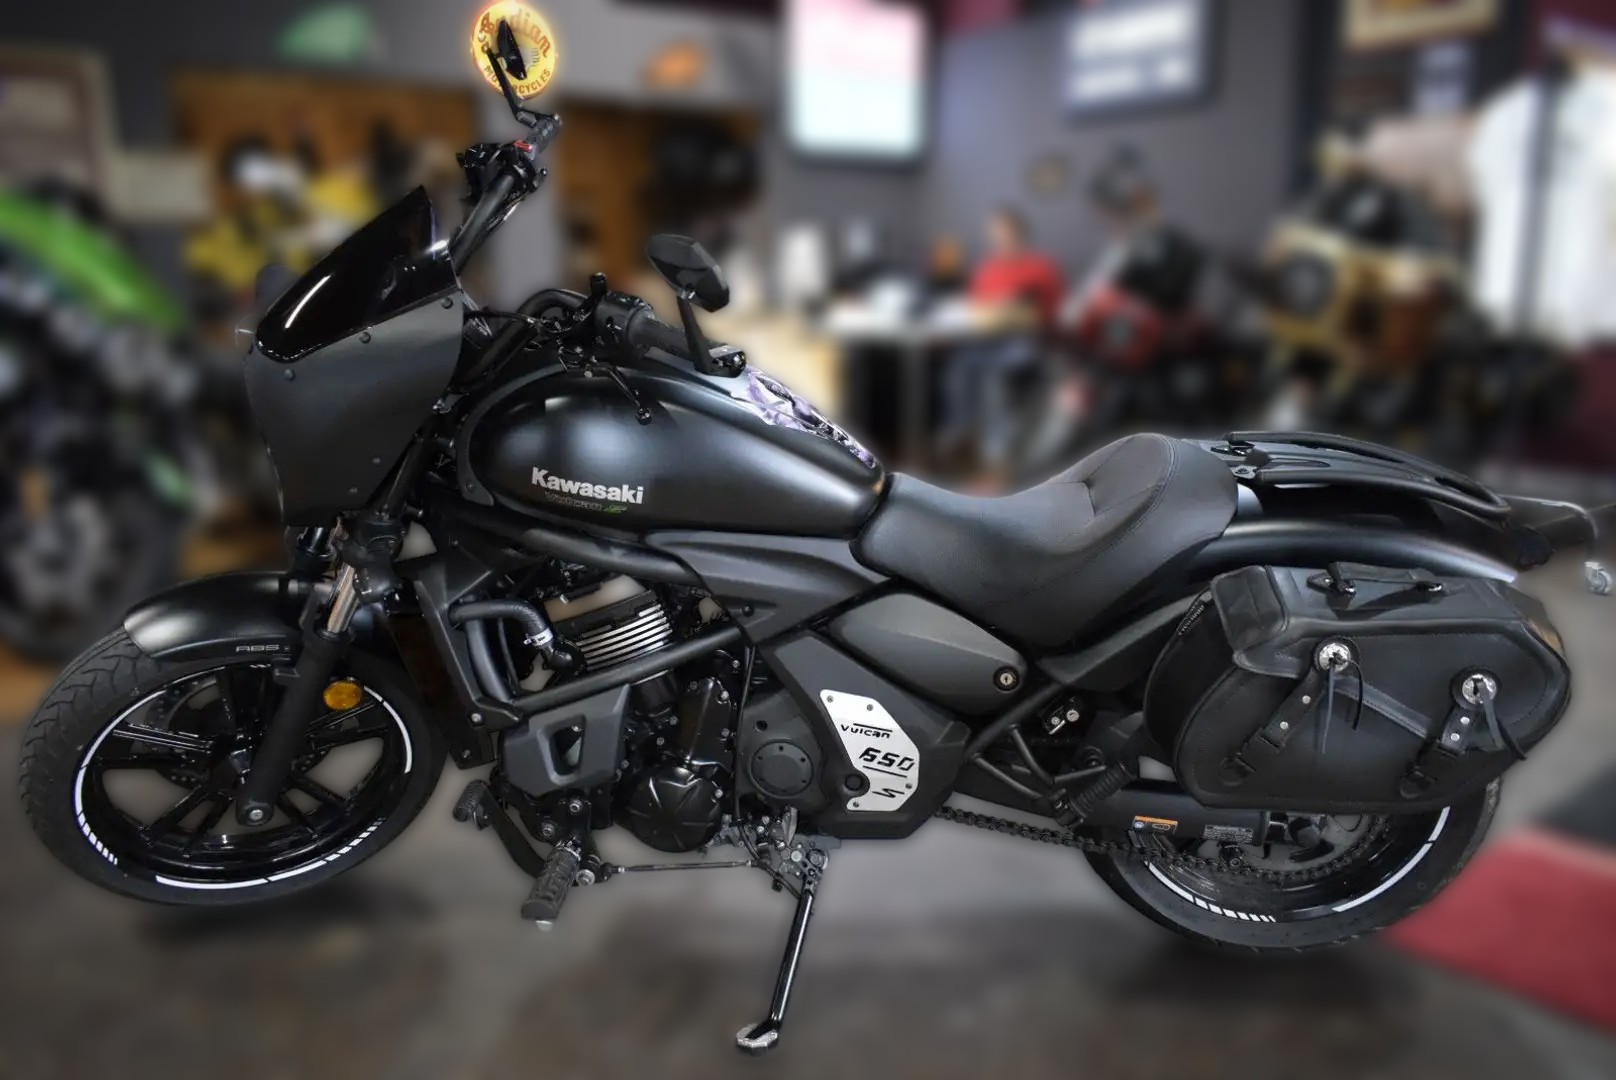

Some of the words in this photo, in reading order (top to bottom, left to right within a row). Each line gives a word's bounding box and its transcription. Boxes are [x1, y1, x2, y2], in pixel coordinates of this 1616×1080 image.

[531, 466, 644, 505] Kawasaki
[236, 644, 279, 652] ABS
[859, 747, 915, 771] 650
